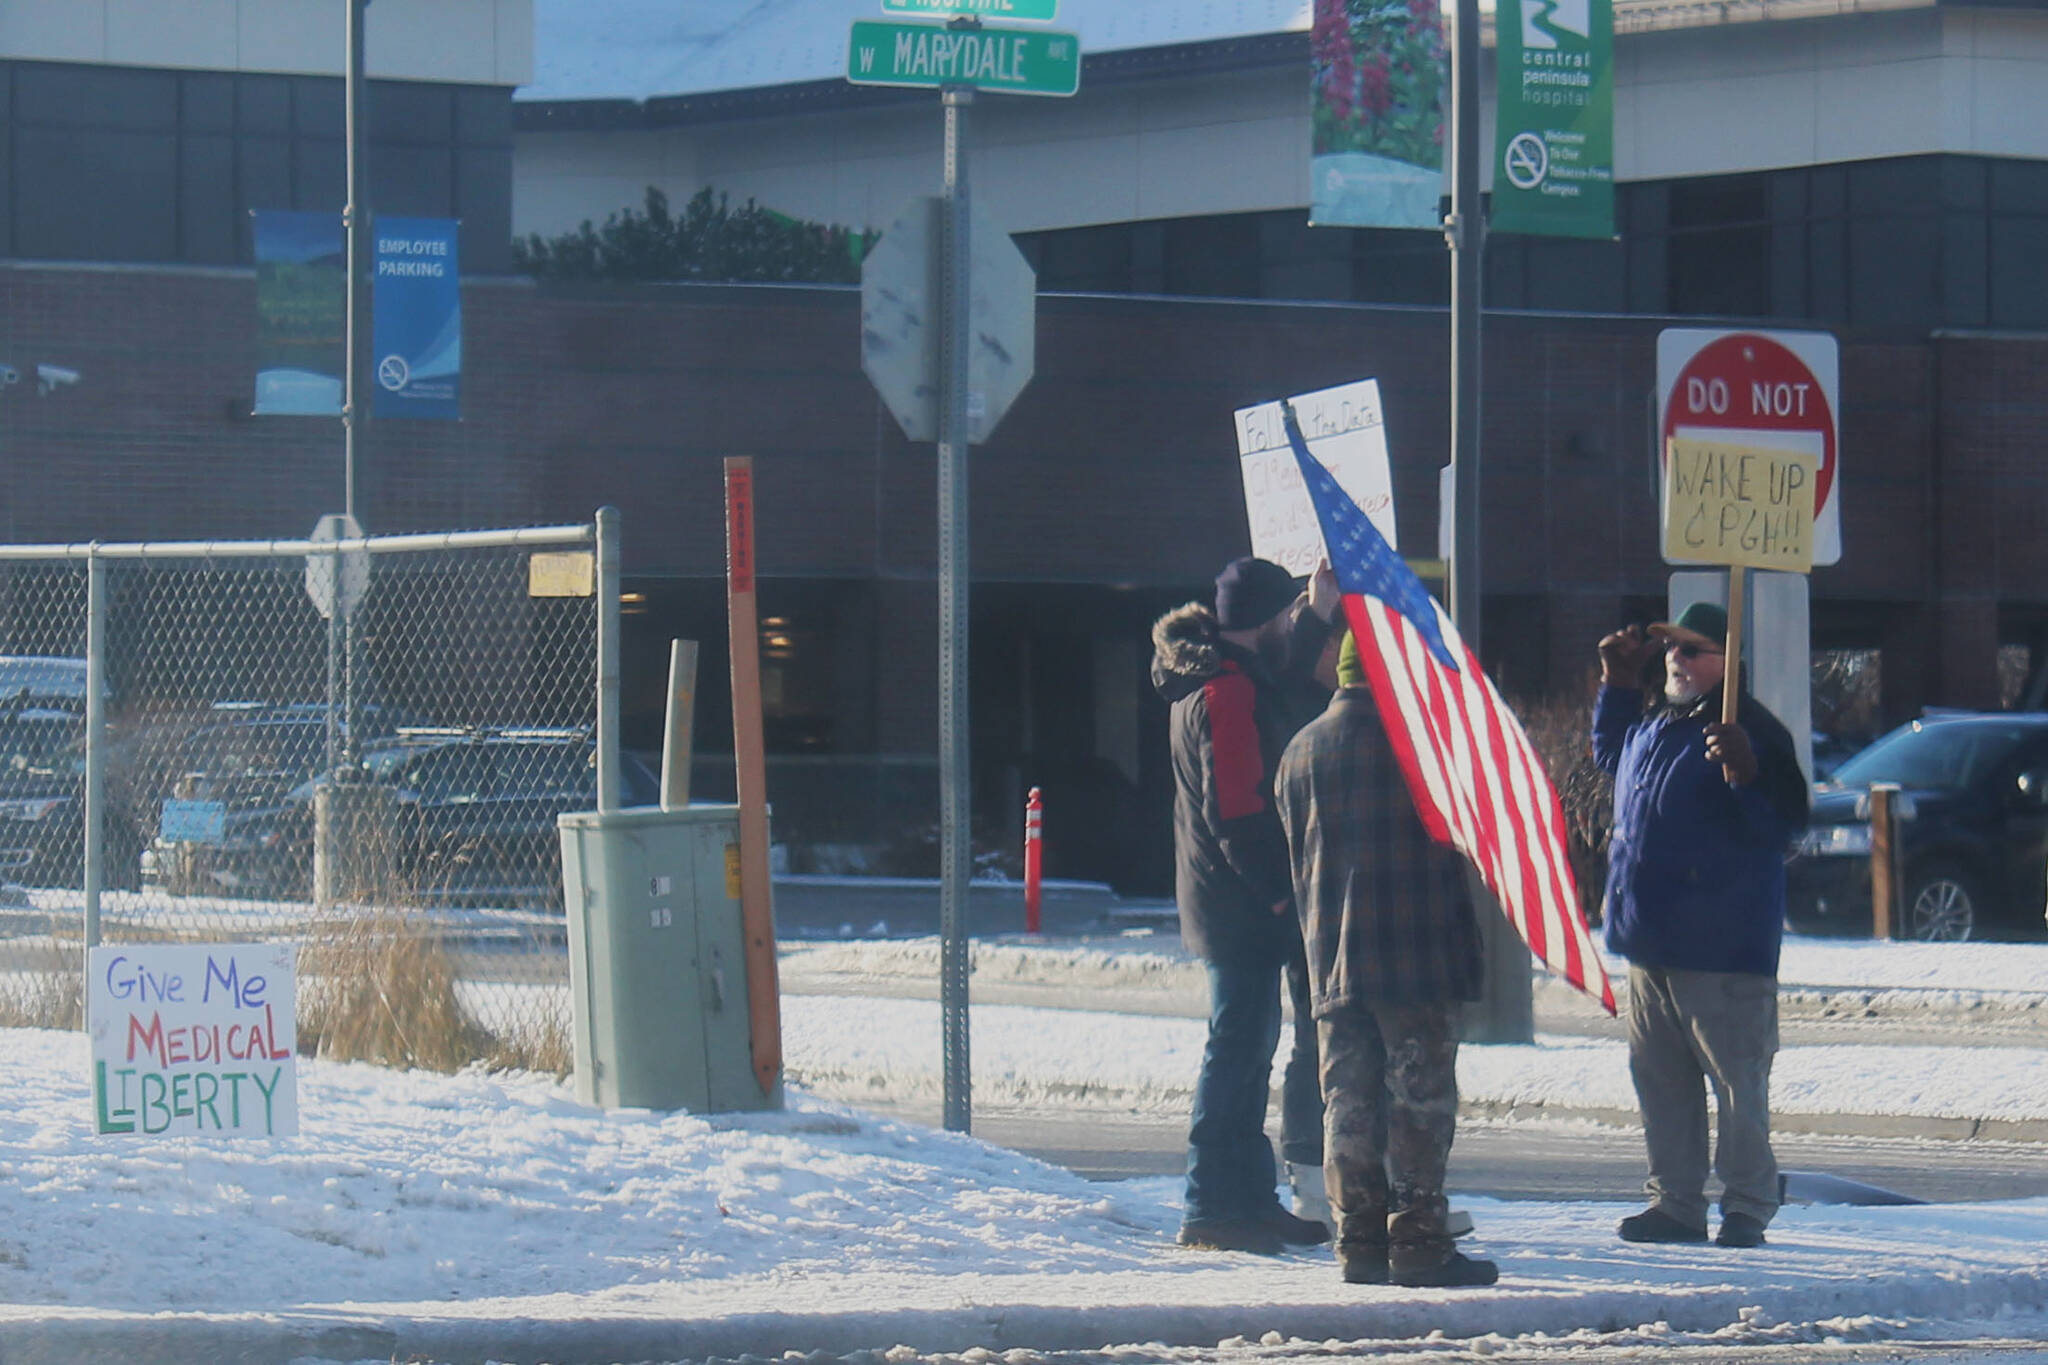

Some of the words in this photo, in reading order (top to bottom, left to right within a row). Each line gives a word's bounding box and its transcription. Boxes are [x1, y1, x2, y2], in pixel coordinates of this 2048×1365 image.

[859, 47, 875, 73] W
[893, 31, 1028, 82] MARYDALE
[1522, 50, 1591, 68] central
[1522, 70, 1590, 87] peninsula
[1522, 88, 1591, 107] hospital
[378, 239, 448, 256] EMPLOYEE
[378, 261, 444, 278] PARKING
[1688, 377, 1729, 415] DO
[1752, 382, 1810, 417] NOT
[1674, 446, 1756, 502] WAKE
[1769, 461, 1805, 507] UP
[106, 956, 185, 1003] Give
[203, 955, 267, 1009] Me
[126, 1003, 290, 1070] MEDICAL
[96, 1060, 282, 1136] LIBERTY
